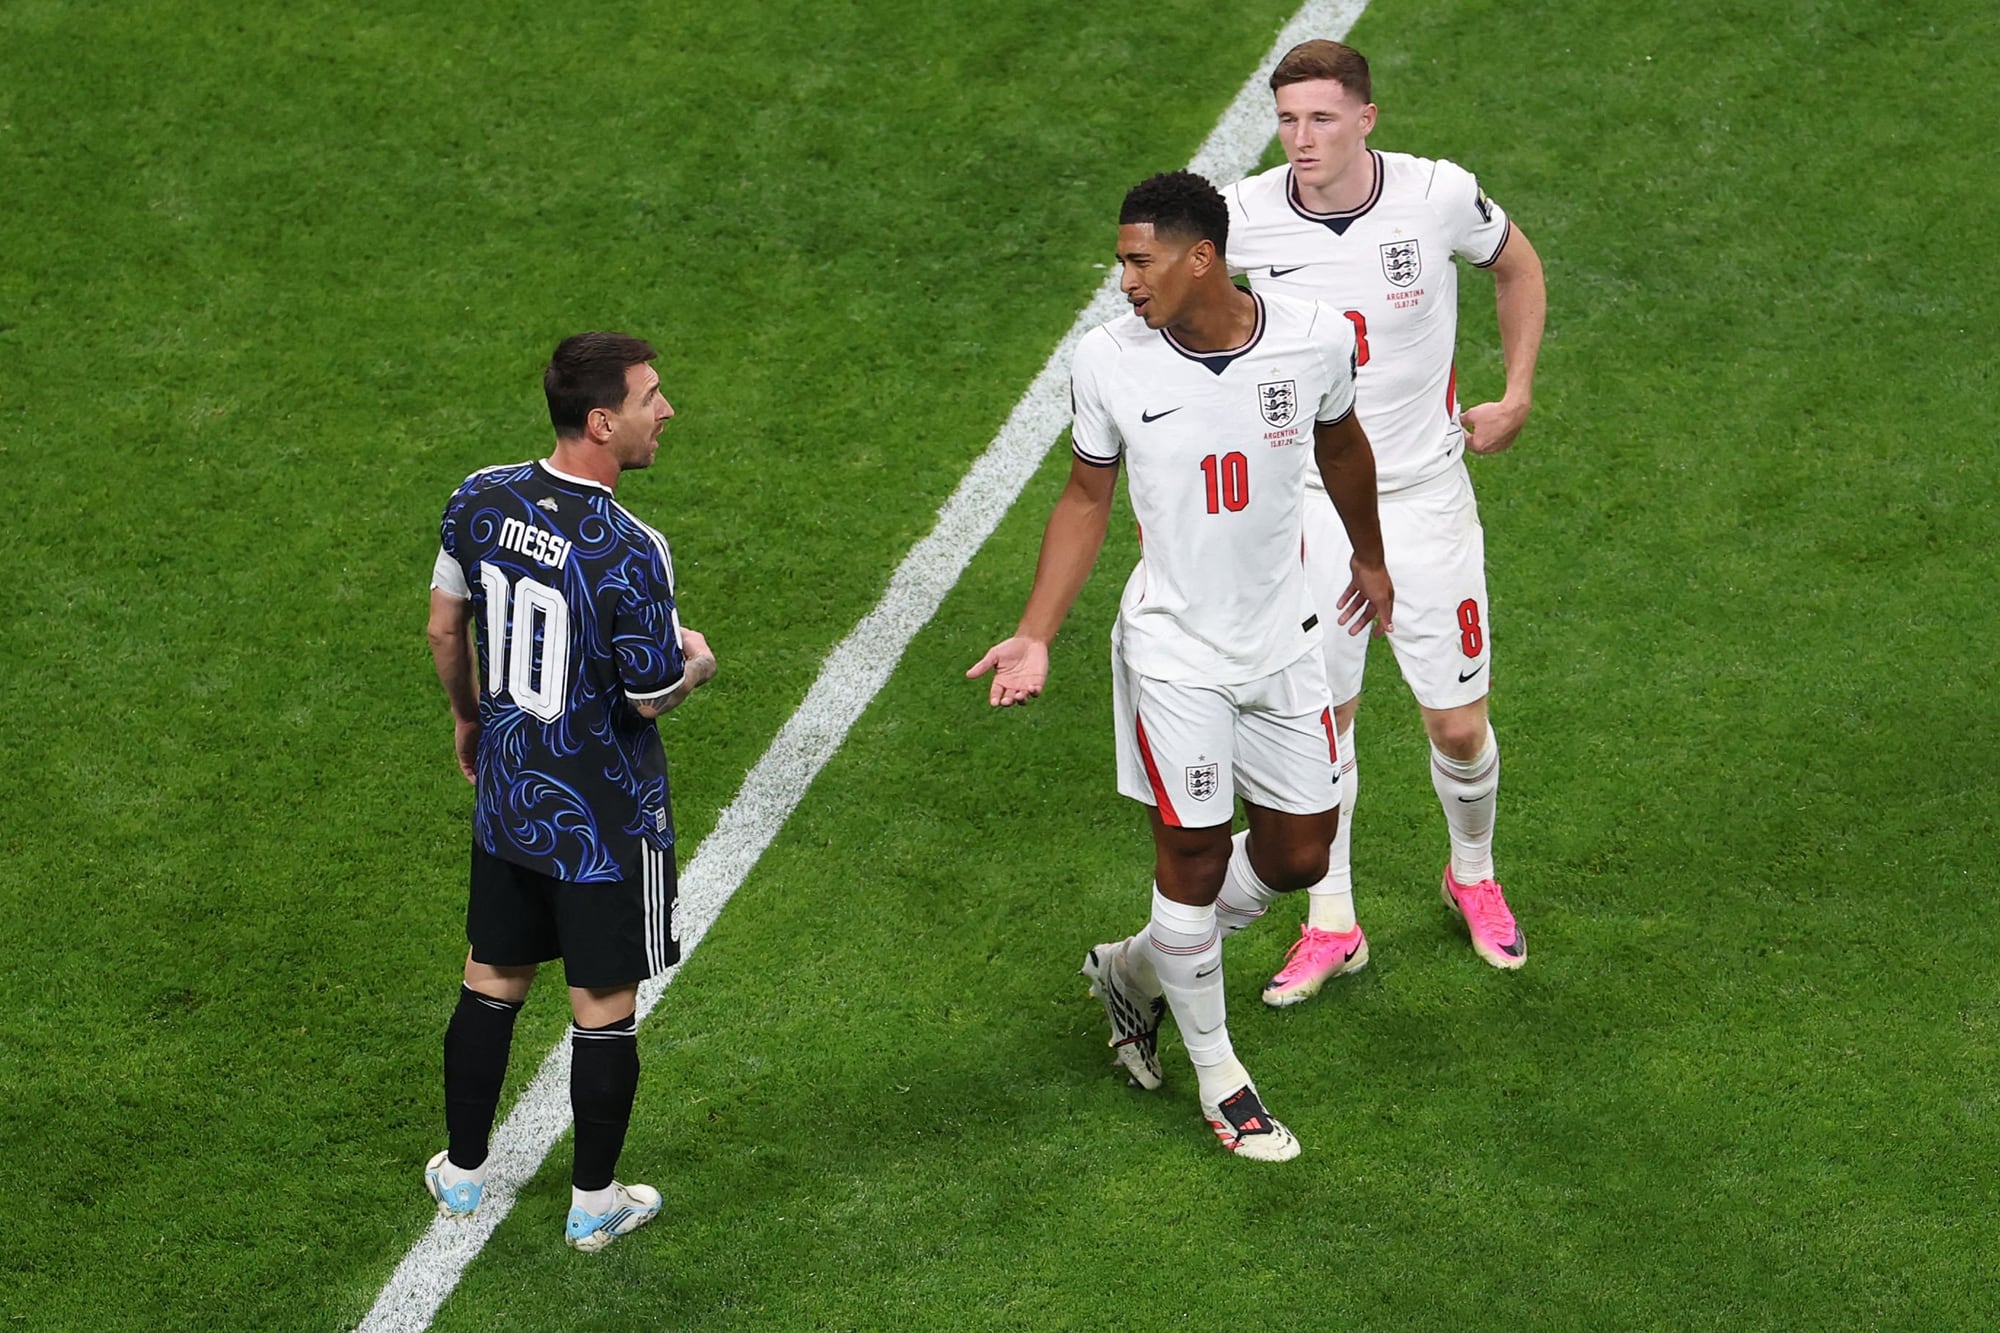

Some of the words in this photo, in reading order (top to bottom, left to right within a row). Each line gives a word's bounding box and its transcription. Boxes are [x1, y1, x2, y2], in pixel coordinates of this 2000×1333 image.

[1387, 289, 1424, 301] ARGENTINA
[1264, 428, 1298, 440] ARGENTINA
[1200, 451, 1249, 514] 10
[498, 517, 572, 570] MESSI
[480, 560, 571, 724] 10
[1457, 598, 1483, 658] 8
